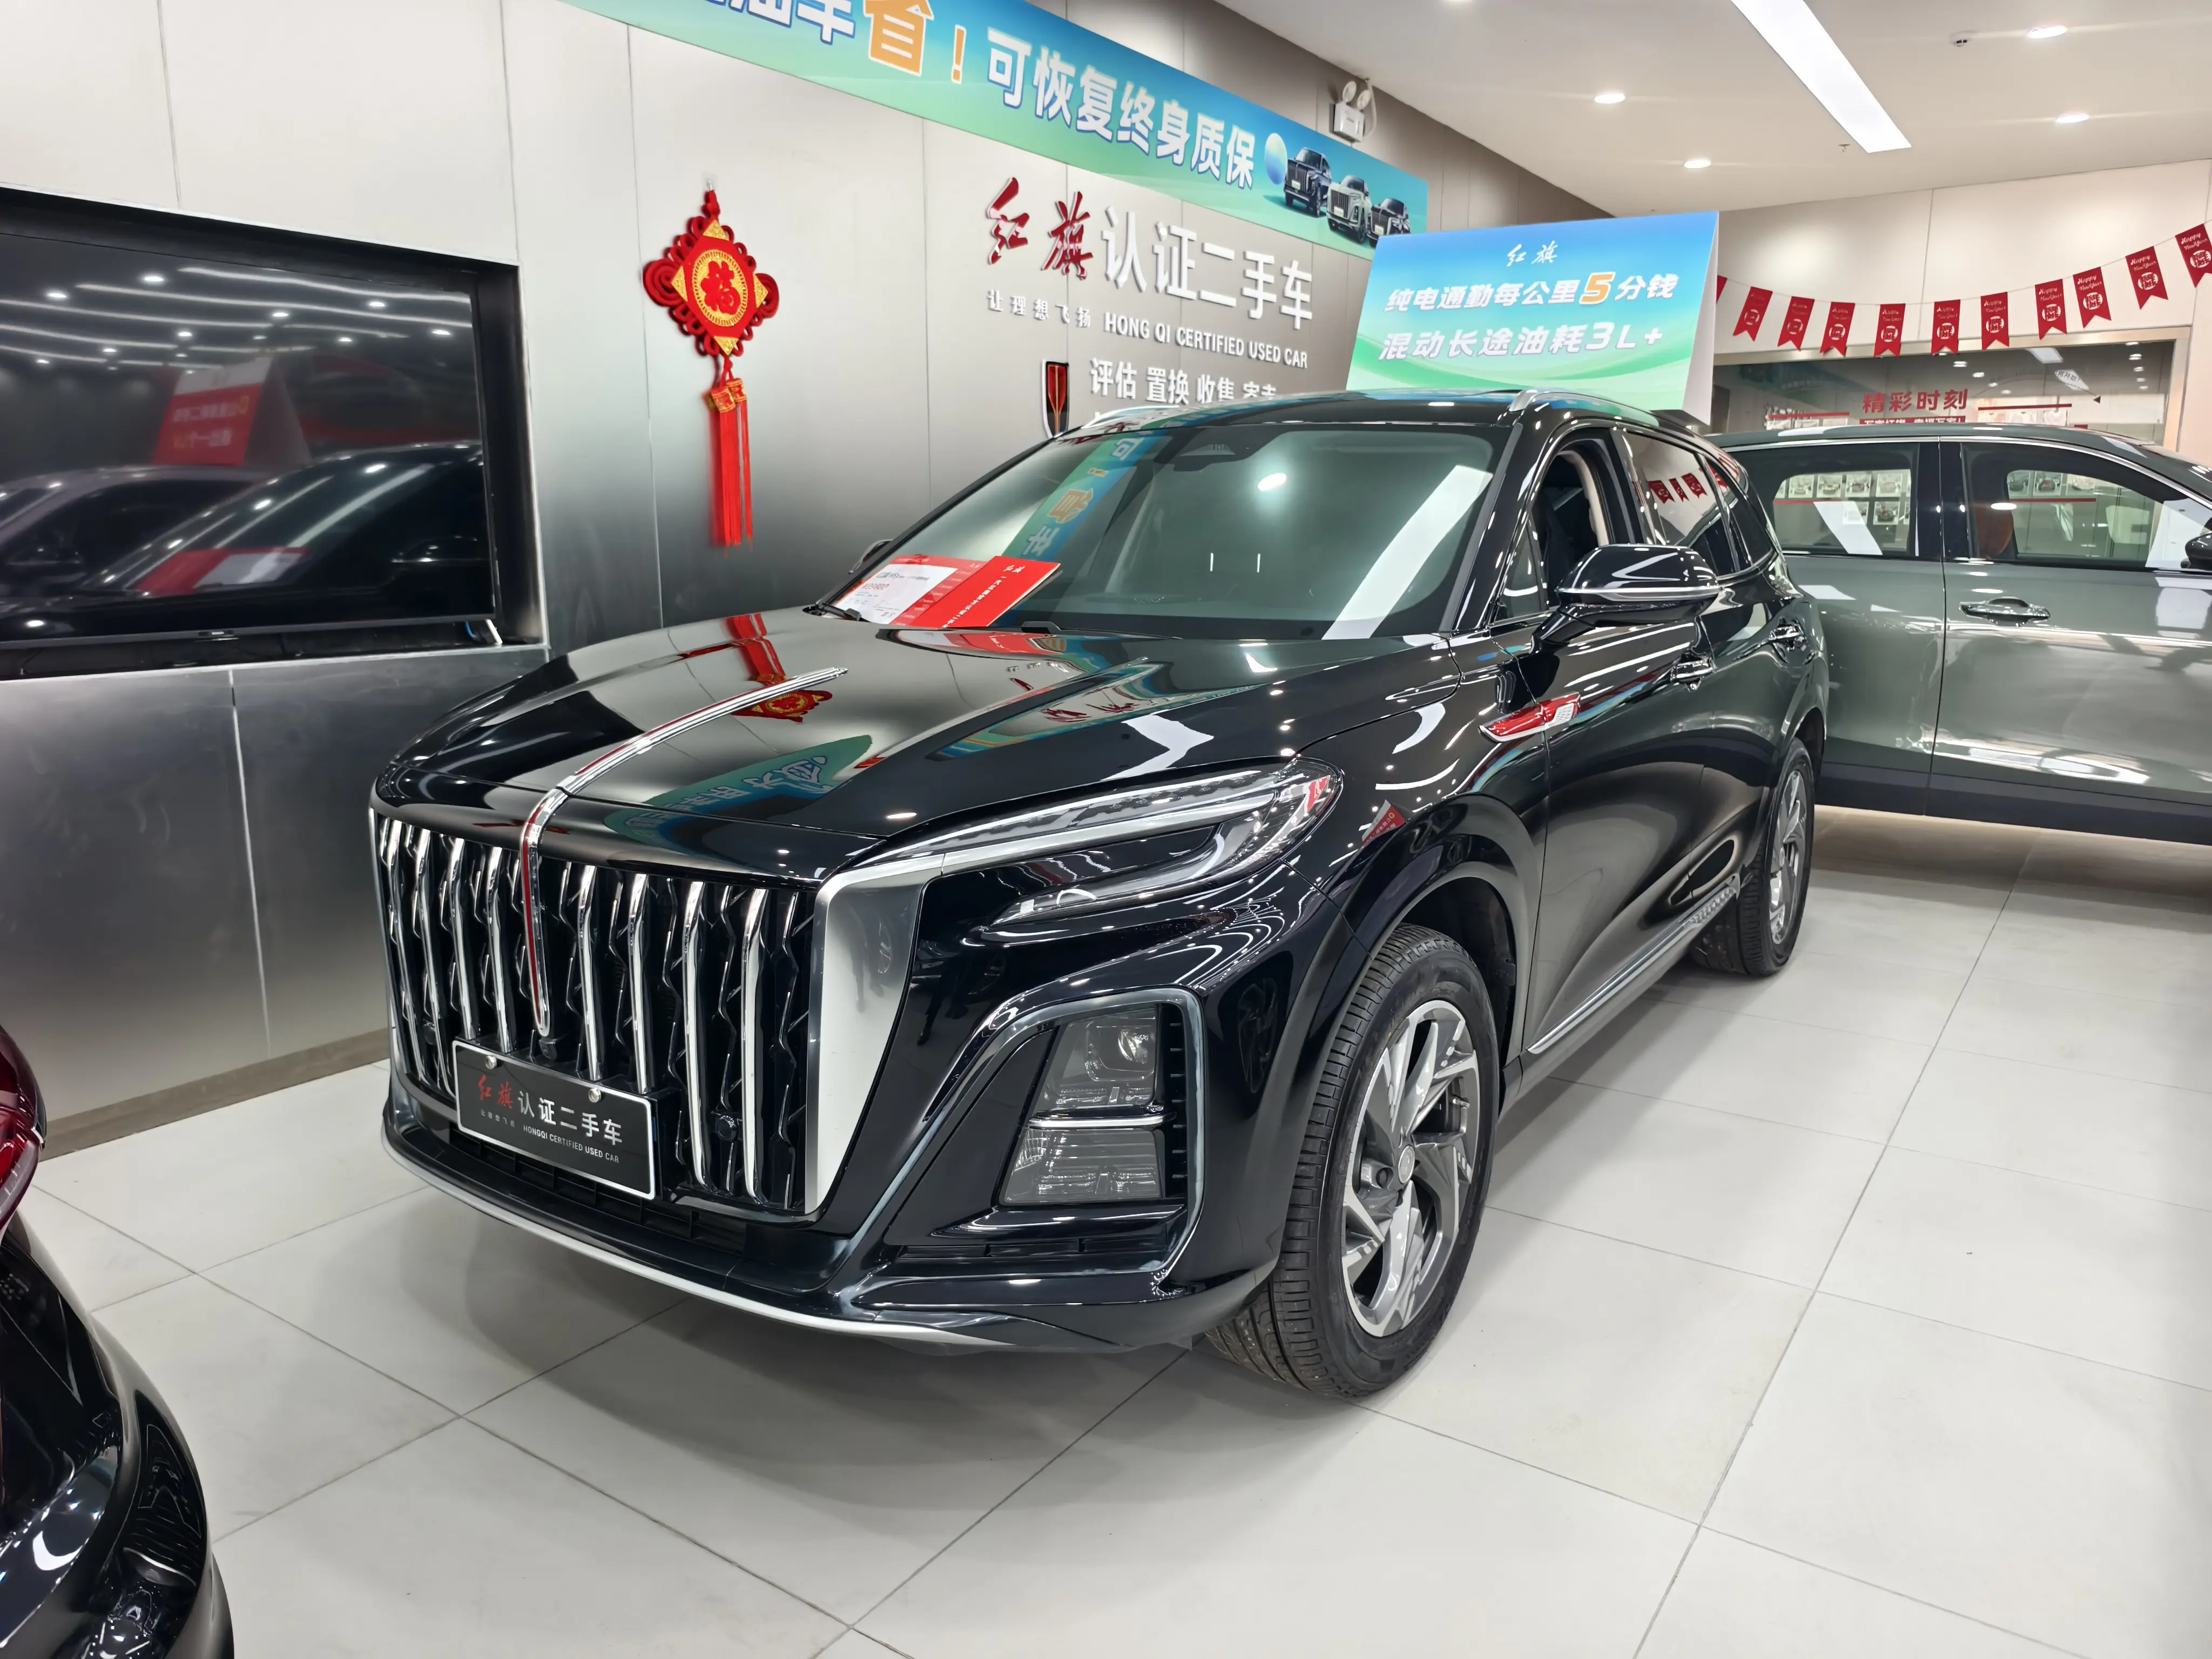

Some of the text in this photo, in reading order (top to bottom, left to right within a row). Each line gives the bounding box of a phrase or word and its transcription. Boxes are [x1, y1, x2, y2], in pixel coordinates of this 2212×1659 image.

[987, 289, 1091, 328] 让理想飞扬
[1384, 272, 1679, 313] 纯电通勤每公里5分钱
[1104, 311, 1308, 369] HONG QI CERTIFIED USED CAR
[1090, 356, 1137, 400] 评估
[1146, 367, 1190, 406] 置换
[1863, 388, 1968, 414] 精彩时刻
[523, 1124, 619, 1164] HONGQI CERTIFIED USED CAR
